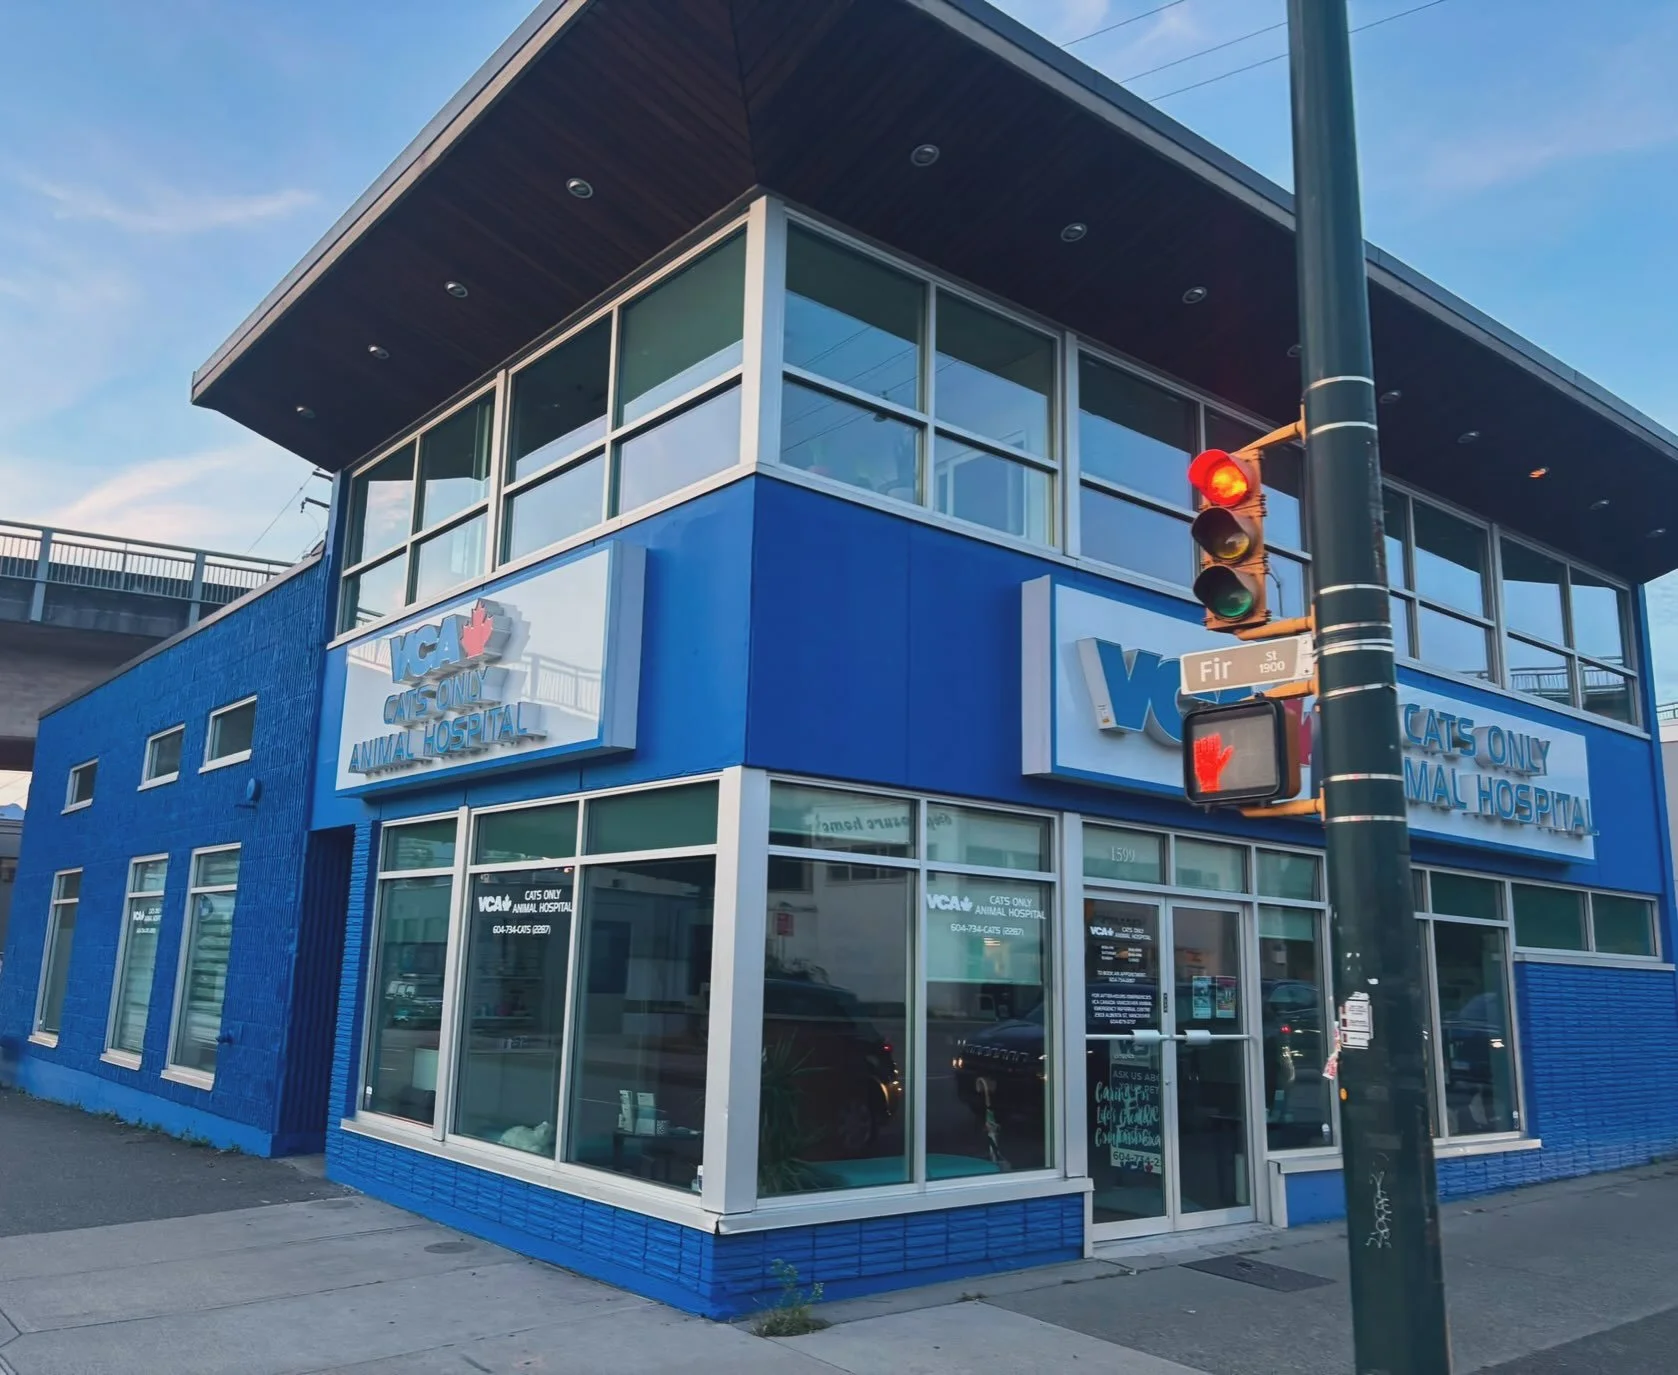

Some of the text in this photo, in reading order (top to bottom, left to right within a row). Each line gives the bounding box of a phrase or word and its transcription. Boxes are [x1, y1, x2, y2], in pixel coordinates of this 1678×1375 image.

[389, 614, 462, 683] VCA
[1265, 651, 1278, 661] St
[1200, 657, 1232, 682] Fir
[1259, 661, 1285, 673] 1900
[383, 665, 489, 725] CATS ONLY
[349, 702, 528, 773] ANIMAL HOSPITAL
[1403, 703, 1551, 777] CATS ONLY
[1404, 756, 1600, 836] MAL HOSPITAL
[478, 895, 504, 912] VCA
[524, 889, 562, 901] CATS ONLY
[926, 893, 961, 911] VCA
[989, 895, 1033, 907] CATS ONLY
[512, 901, 573, 914] ANIMAL HOSPITAL
[974, 905, 1047, 920] ANIMAL HOSPITAL
